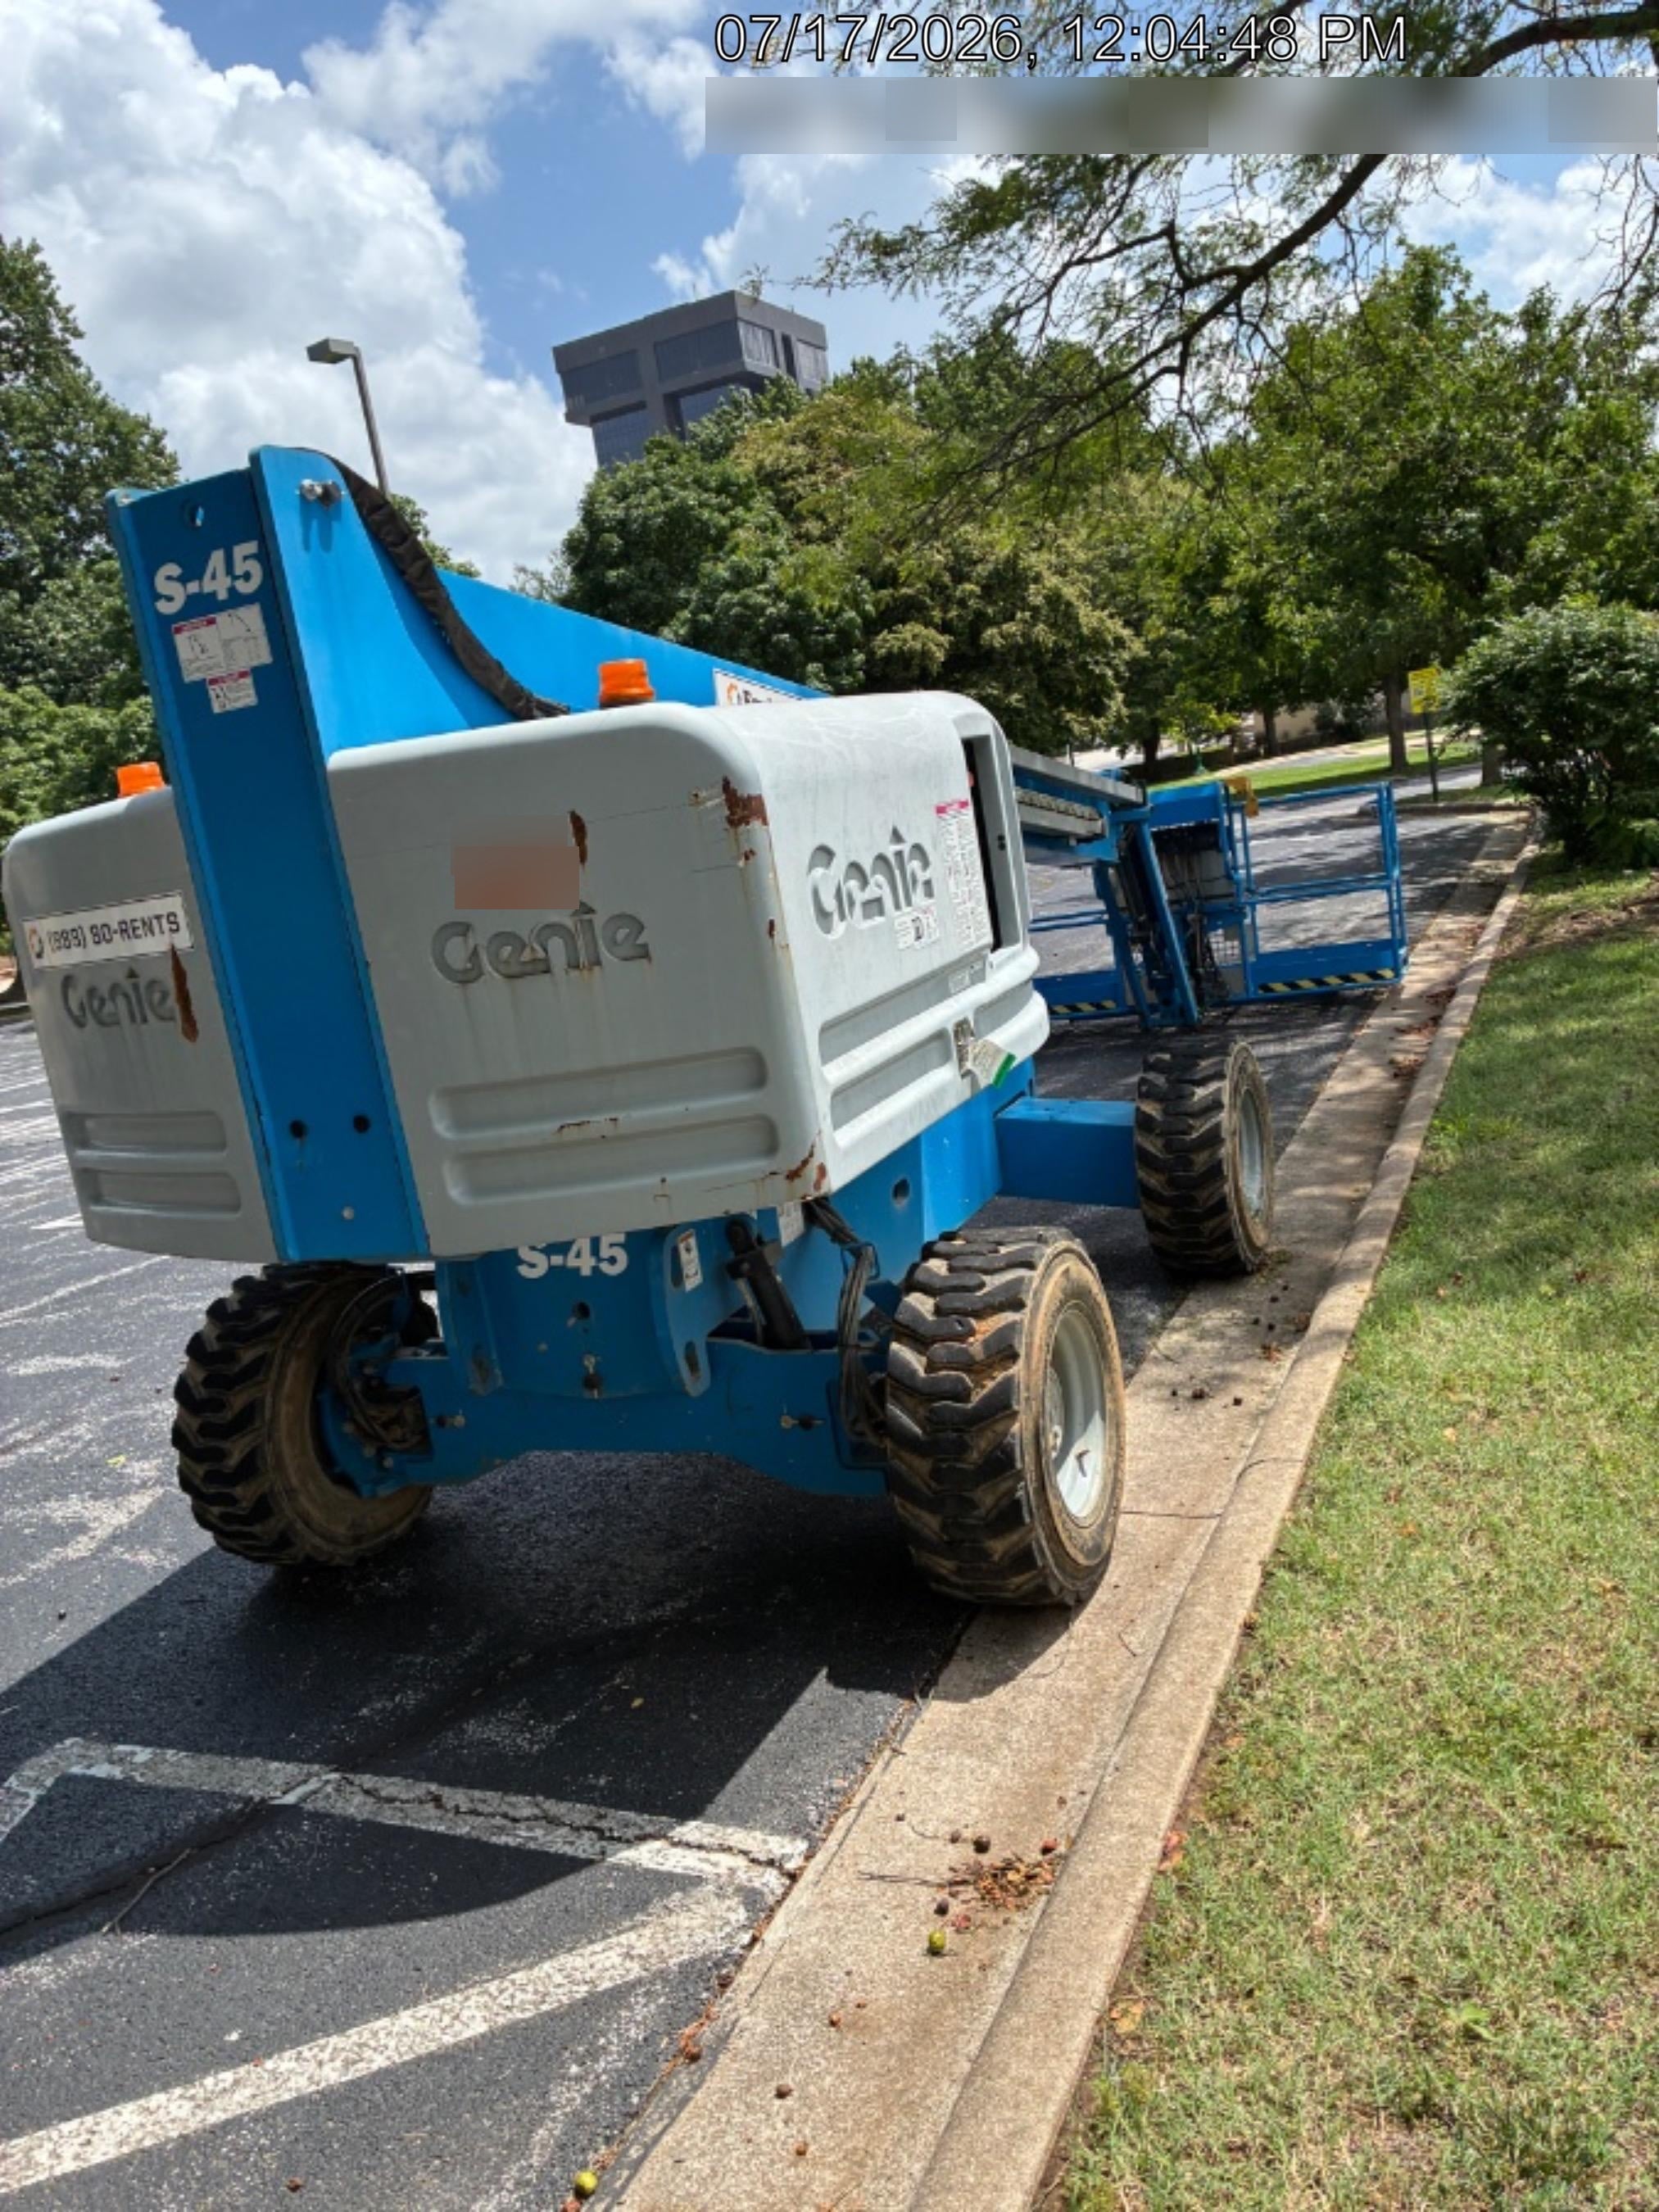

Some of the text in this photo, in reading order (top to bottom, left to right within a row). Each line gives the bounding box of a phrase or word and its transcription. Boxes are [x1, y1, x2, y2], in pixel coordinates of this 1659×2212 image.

[154, 541, 263, 614] S-45
[807, 824, 935, 939] Genie
[431, 900, 650, 984] Genie
[61, 966, 176, 1028] Genie
[516, 1231, 629, 1279] S-45
